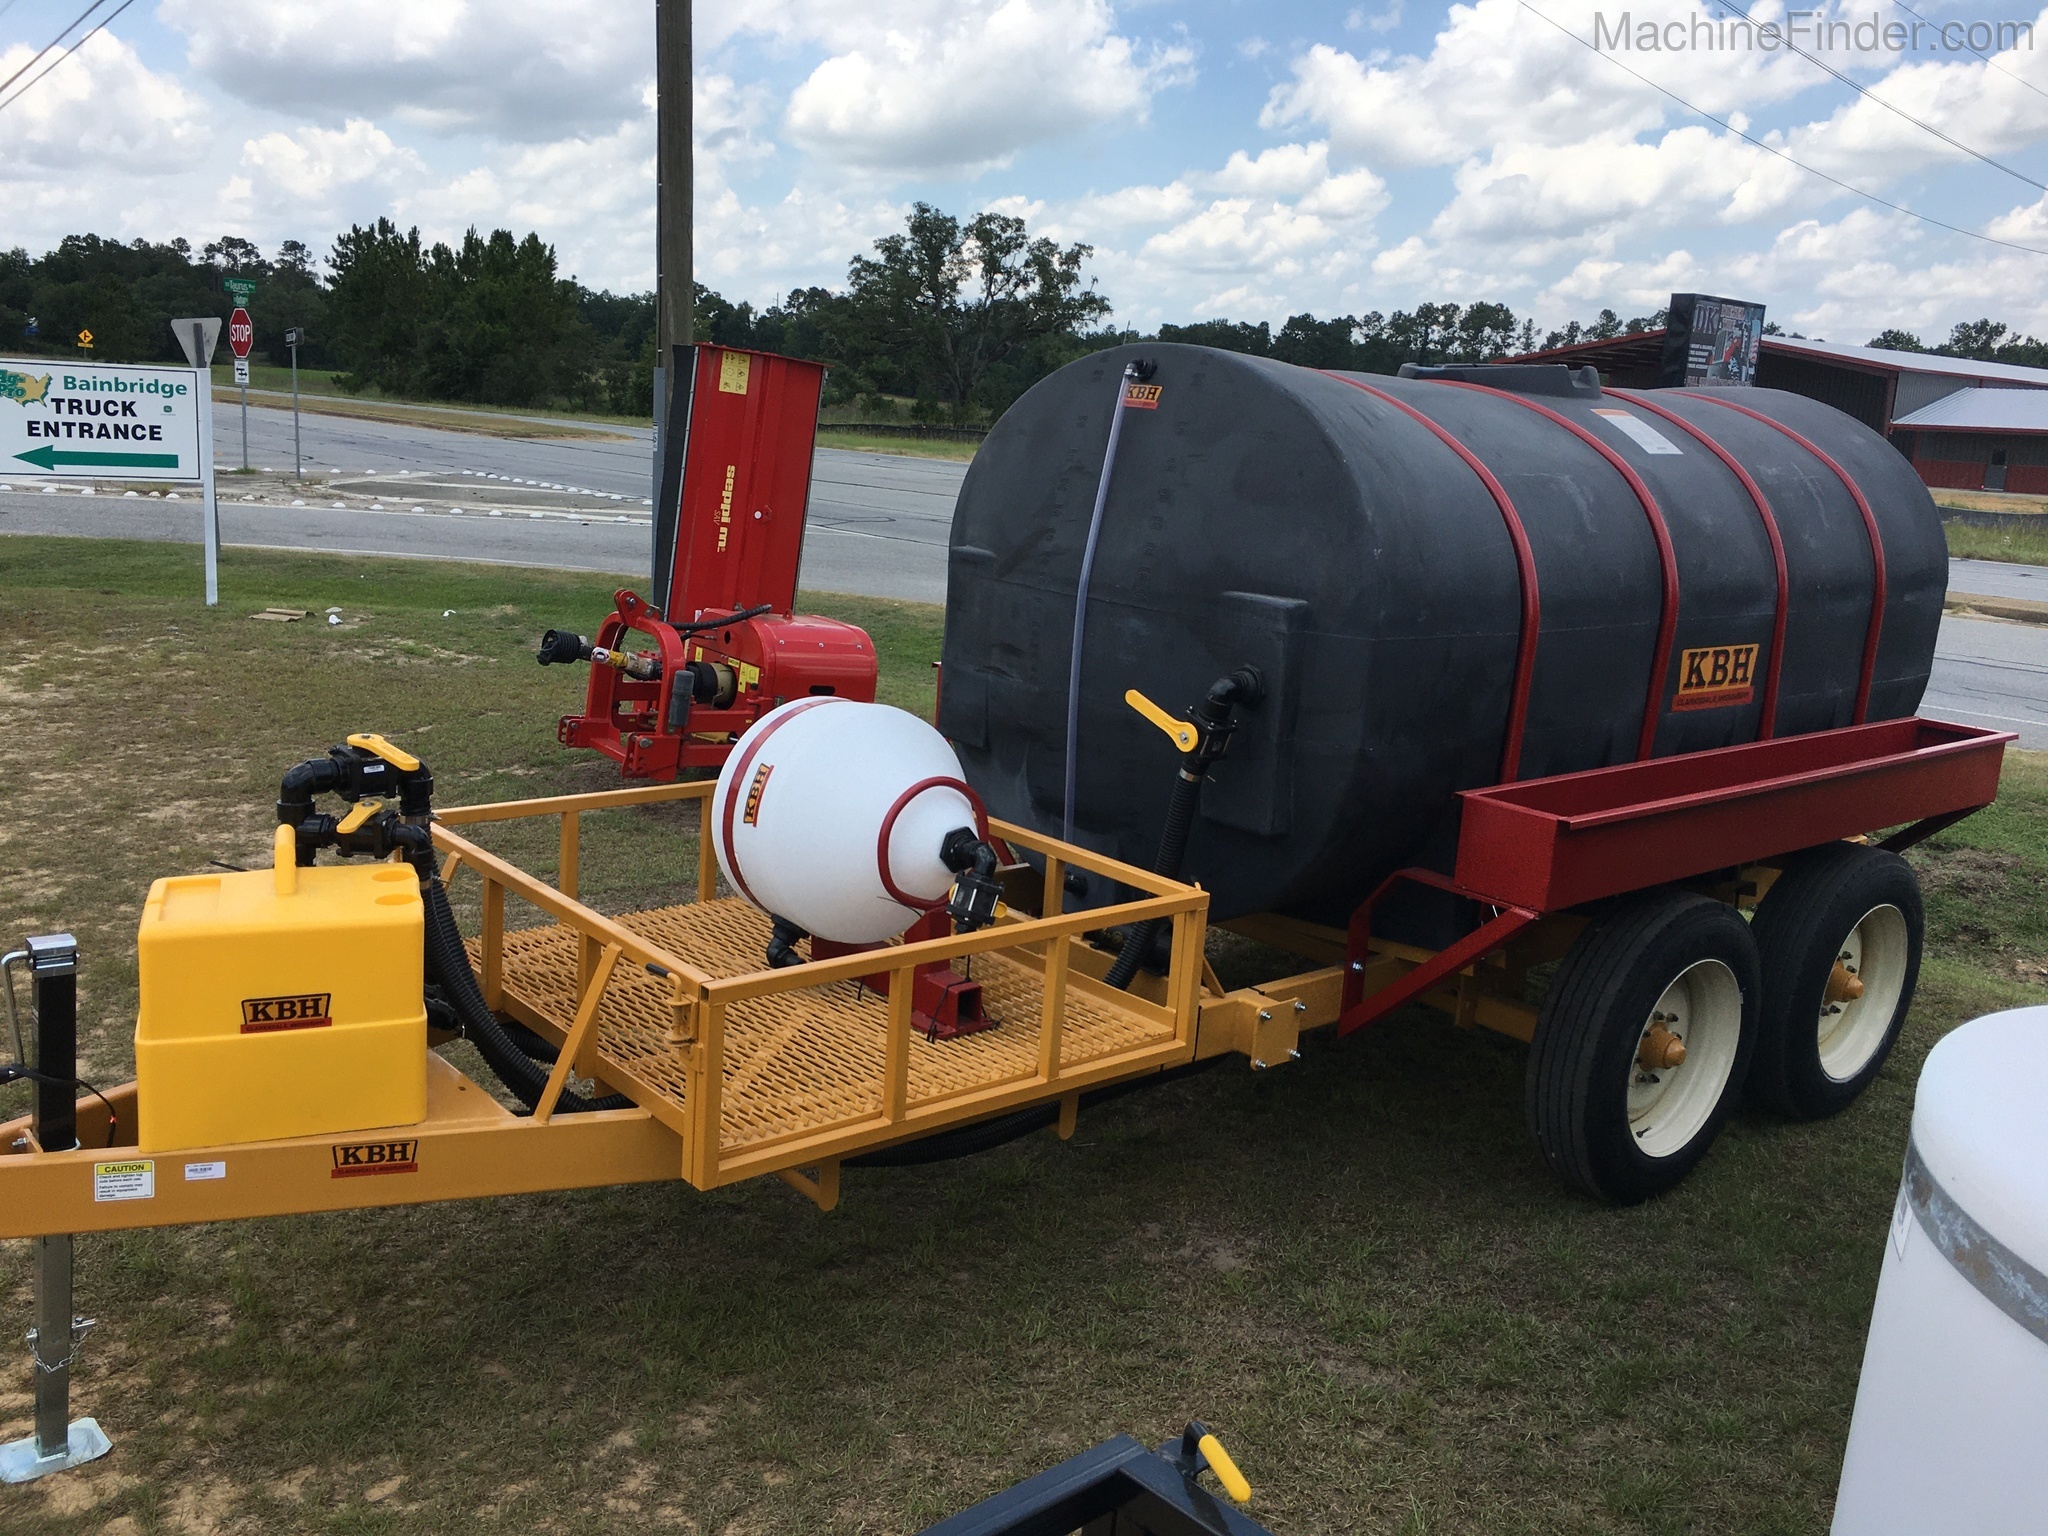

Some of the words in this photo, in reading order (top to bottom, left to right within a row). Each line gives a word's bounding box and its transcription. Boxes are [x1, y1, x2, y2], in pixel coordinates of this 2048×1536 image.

[231, 324, 251, 342] STOP
[63, 375, 188, 399] Bainbridge
[1127, 385, 1160, 401] KBH
[50, 397, 138, 418] TRUCK
[27, 420, 163, 441] ENTRANCE
[720, 464, 735, 523] seppi
[1683, 647, 1754, 689] KBH
[746, 771, 767, 817] KBH
[248, 997, 323, 1023] KBH
[340, 1142, 411, 1165] KBH
[104, 1164, 144, 1172] CAUTION
